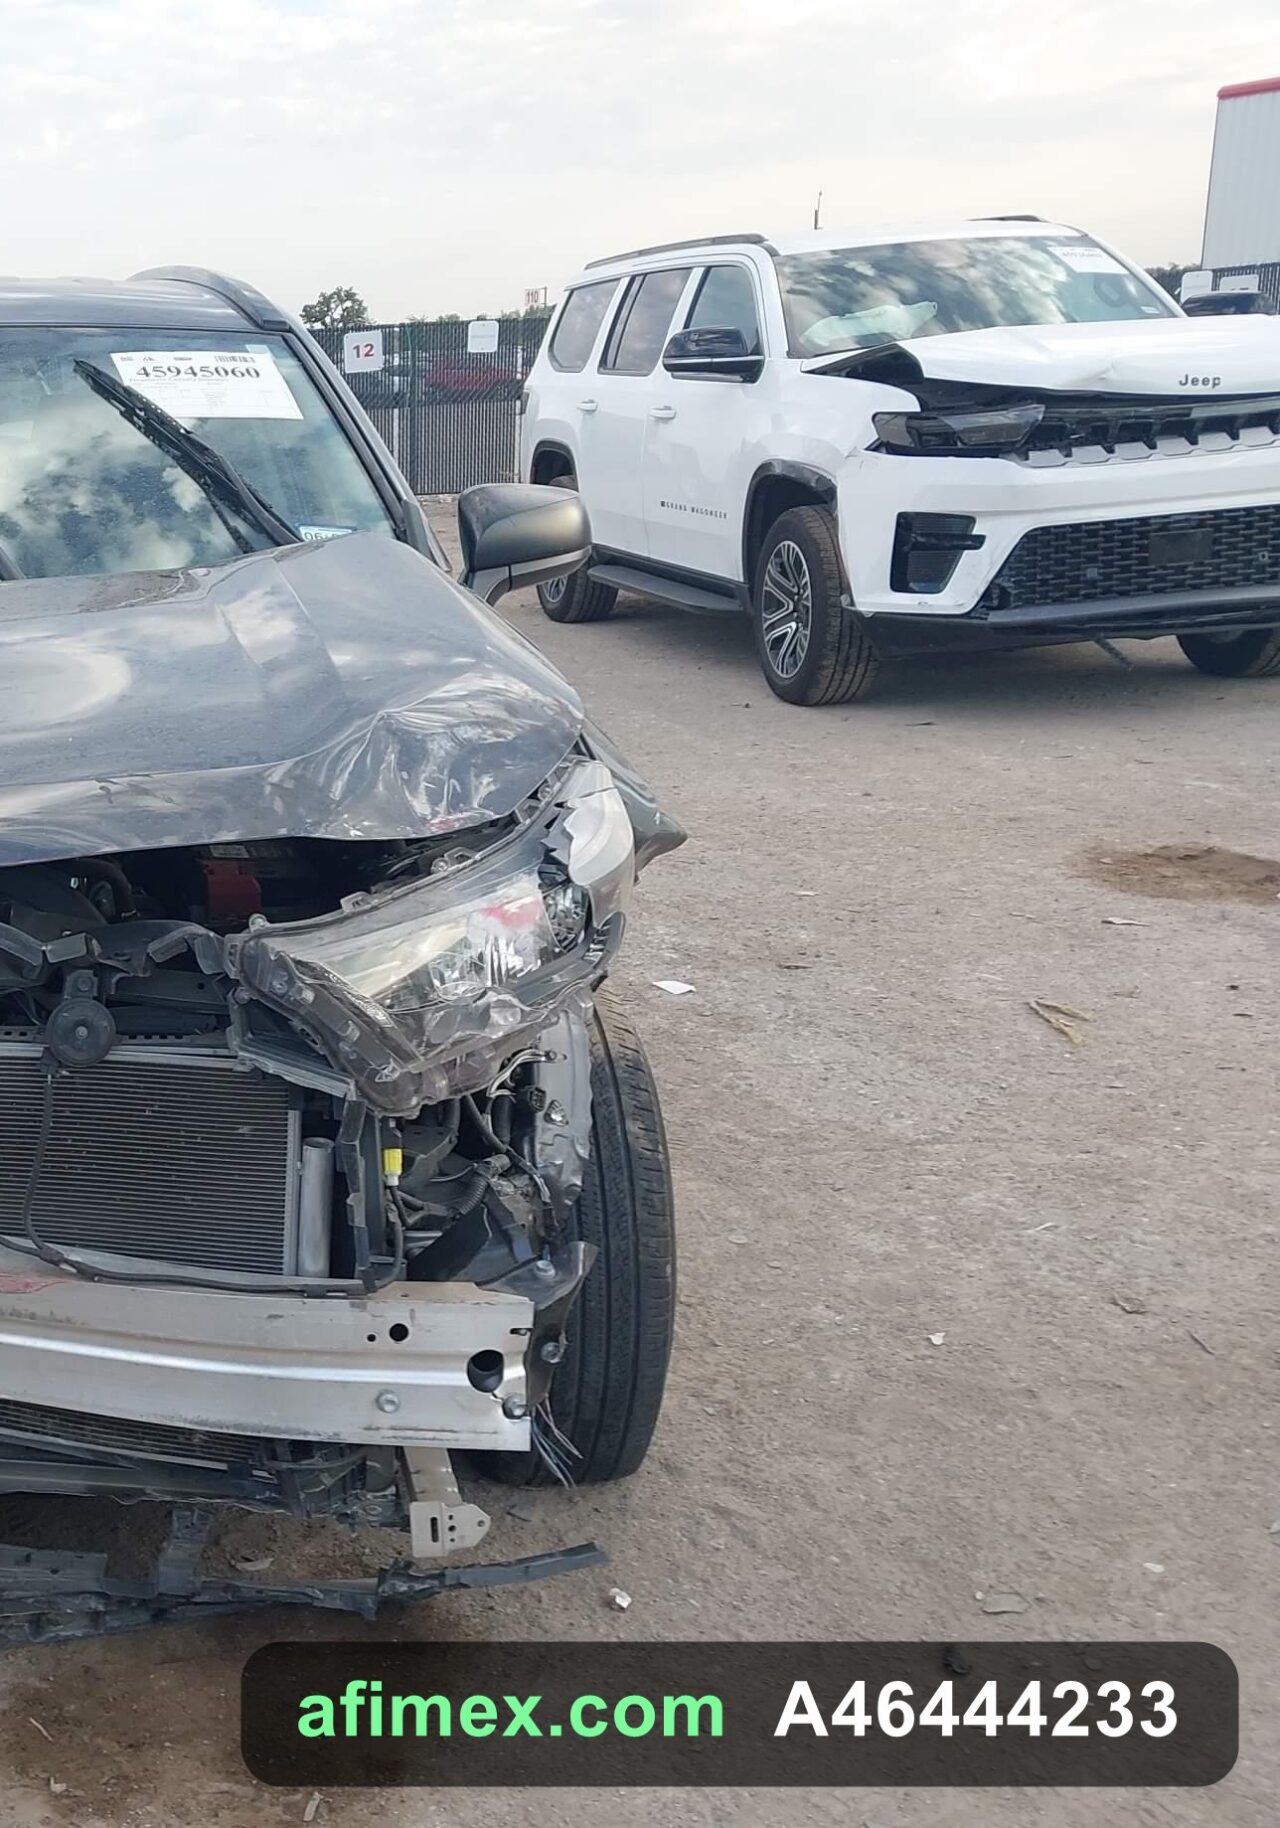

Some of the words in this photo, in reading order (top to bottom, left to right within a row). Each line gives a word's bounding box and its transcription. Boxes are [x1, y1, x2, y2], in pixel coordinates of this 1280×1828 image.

[352, 343, 375, 358] 12
[136, 365, 260, 379] 45945060
[1178, 374, 1221, 389] Jeep
